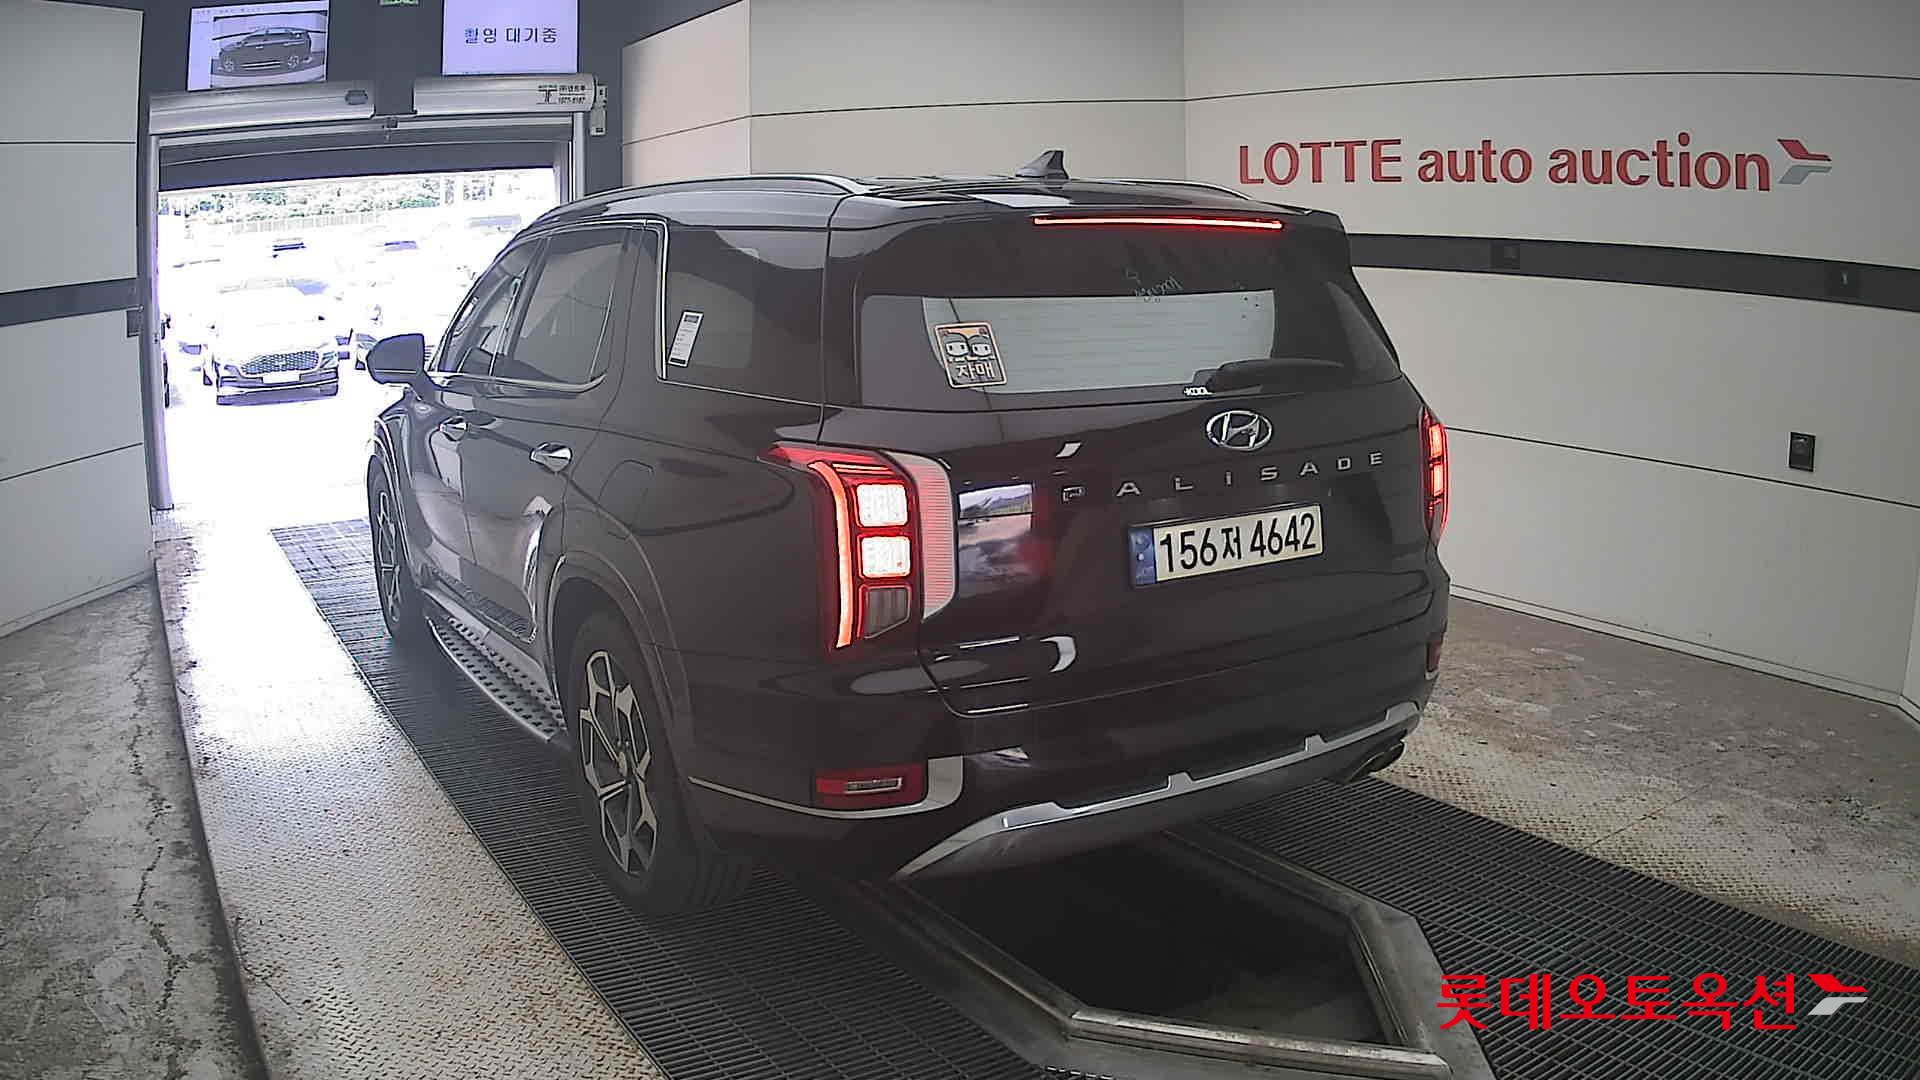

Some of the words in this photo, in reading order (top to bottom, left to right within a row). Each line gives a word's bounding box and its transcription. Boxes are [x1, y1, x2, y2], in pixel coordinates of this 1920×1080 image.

[505, 27, 557, 44] 대기중
[1239, 139, 1402, 185] LOTTE
[1417, 140, 1533, 184] auto
[1548, 132, 1771, 192] auction
[956, 362, 996, 380] 자매
[1062, 452, 1384, 502] PALISADE
